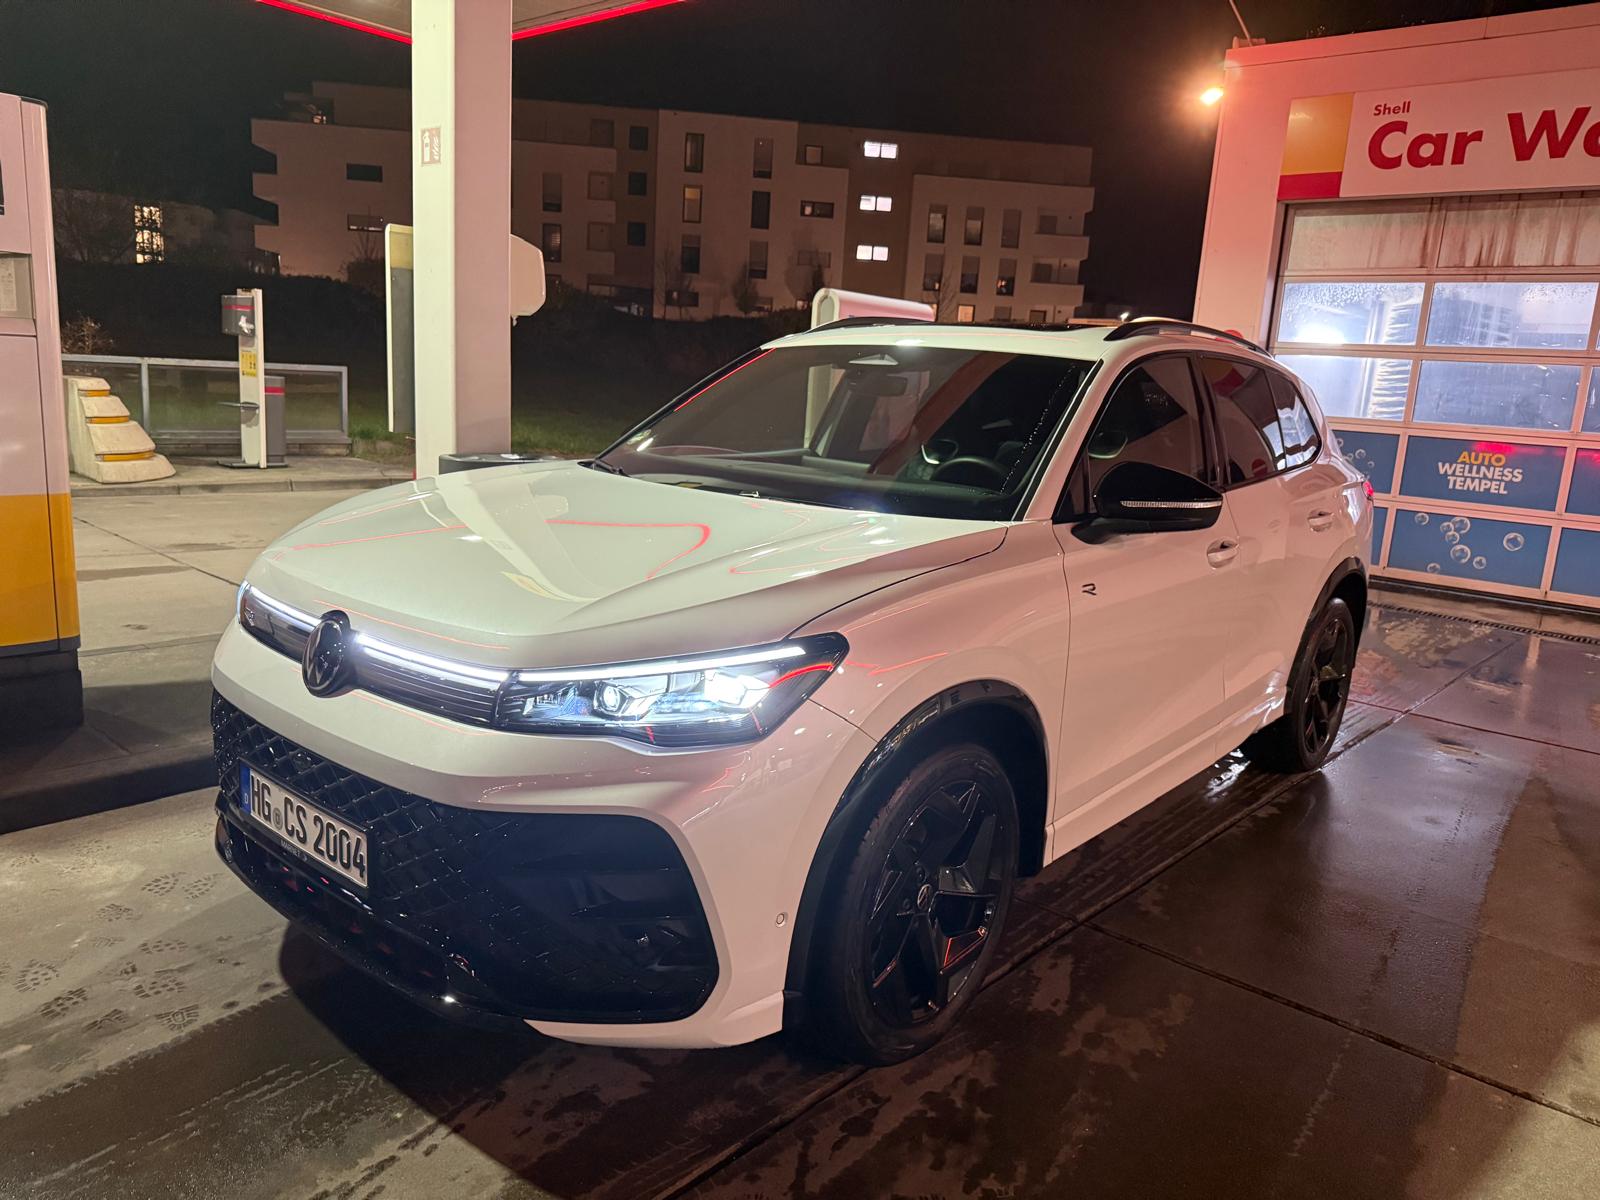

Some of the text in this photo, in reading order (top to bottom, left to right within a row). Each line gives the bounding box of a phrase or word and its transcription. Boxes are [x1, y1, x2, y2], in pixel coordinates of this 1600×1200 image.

[1373, 101, 1411, 116] Shell
[1368, 120, 1484, 170] Car
[1457, 451, 1506, 467] AUTO
[1438, 462, 1523, 482] WELLNESS
[1447, 476, 1508, 494] TEMPEL
[251, 774, 366, 878] HG CS 2004
